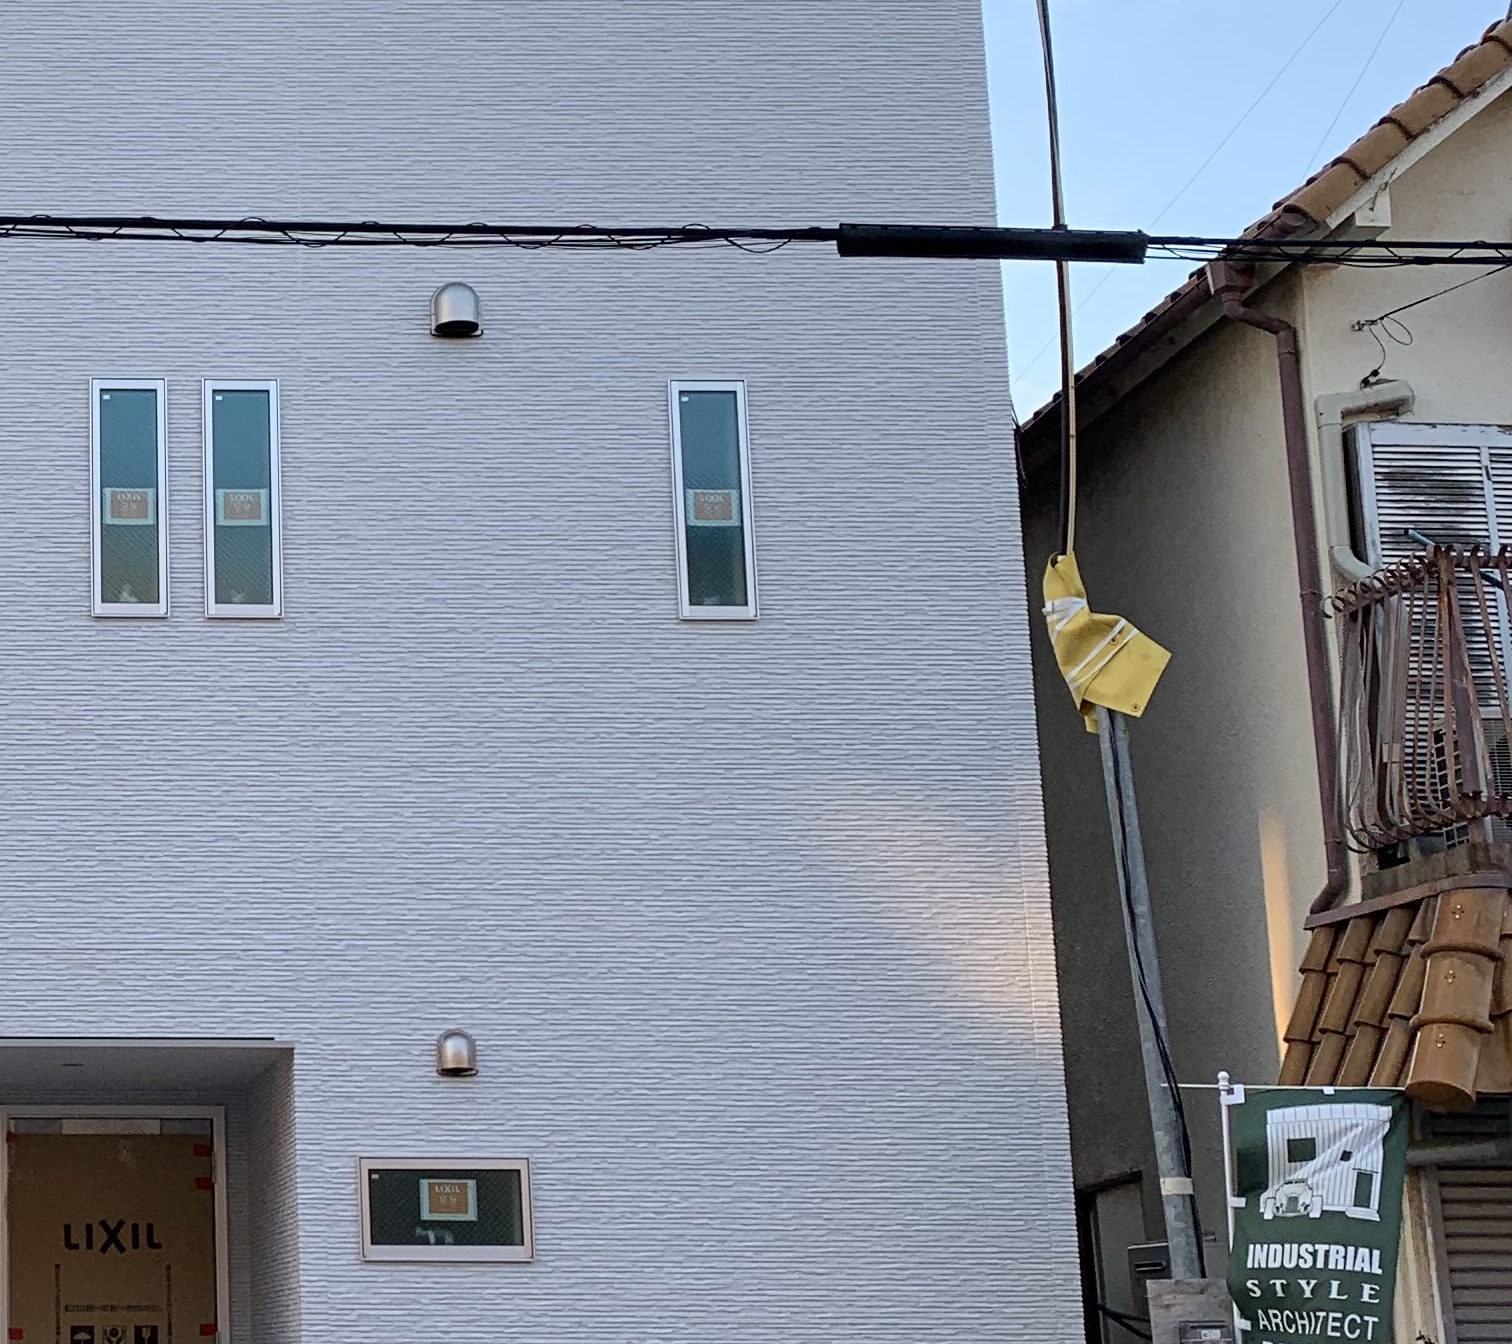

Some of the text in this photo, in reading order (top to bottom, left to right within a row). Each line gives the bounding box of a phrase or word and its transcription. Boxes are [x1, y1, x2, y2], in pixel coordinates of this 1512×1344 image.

[435, 1184, 461, 1193] LIXIL
[63, 1218, 163, 1255] LIXIL
[1246, 1242, 1384, 1275] INDUSTRIAL
[1245, 1278, 1381, 1304] STYLE
[1257, 1308, 1380, 1341] ARCHITECT
